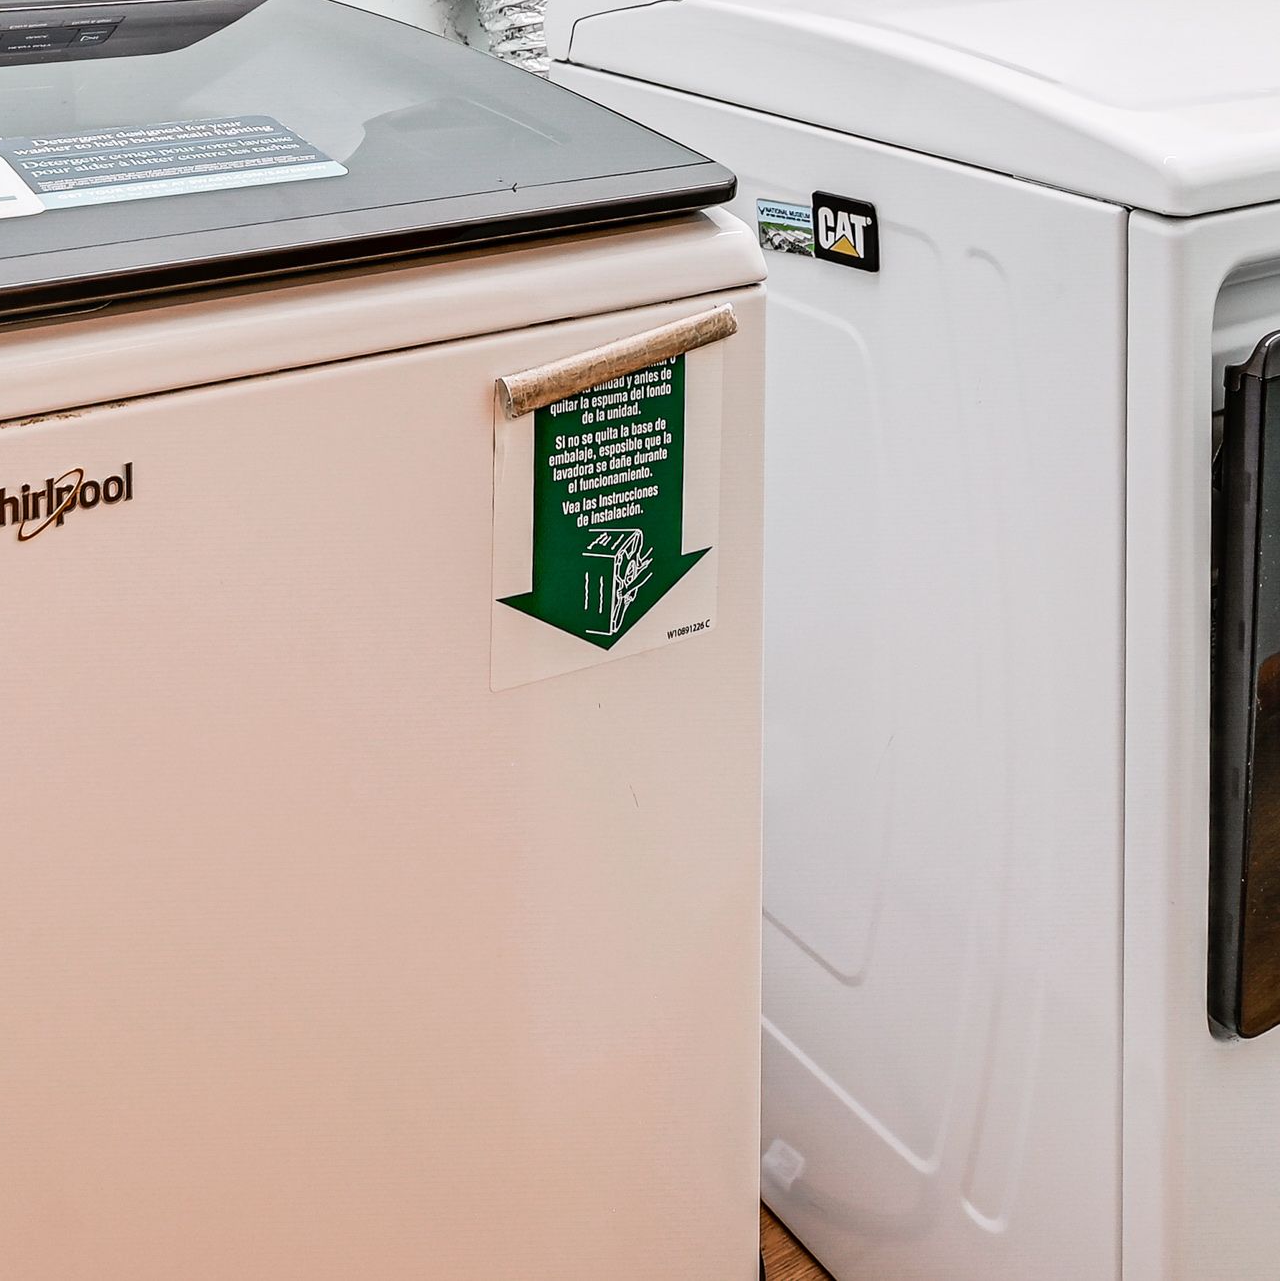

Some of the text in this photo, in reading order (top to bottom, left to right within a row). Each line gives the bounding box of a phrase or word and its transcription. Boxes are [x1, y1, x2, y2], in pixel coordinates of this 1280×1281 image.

[14, 125, 274, 156] washer to help boost stain fighting
[31, 121, 242, 147] Detergent designed for your
[21, 135, 294, 169] Détergent conçu pour votre laveuse
[31, 167, 71, 178] pour
[75, 158, 116, 172] aider
[118, 159, 130, 167] à
[131, 154, 175, 166] lutter
[177, 150, 228, 161] contre
[228, 146, 251, 155] les
[251, 142, 300, 153] taches
[789, 210, 811, 218] MUSEUM
[626, 375, 632, 389] y
[634, 371, 659, 385] antes
[660, 367, 672, 379] de
[550, 383, 672, 417] quitar la espuma del fondo
[582, 402, 641, 424] de la unidad.
[548, 431, 672, 466] embalaje, esposible que la
[555, 417, 666, 450] Si no se quita la base de
[553, 447, 668, 481] lavadora se dañe durante
[568, 466, 653, 494] el funcionamiento.
[562, 485, 659, 515] Vea las Instrucciones
[577, 502, 644, 528] de instalación.
[705, 619, 711, 628] C
